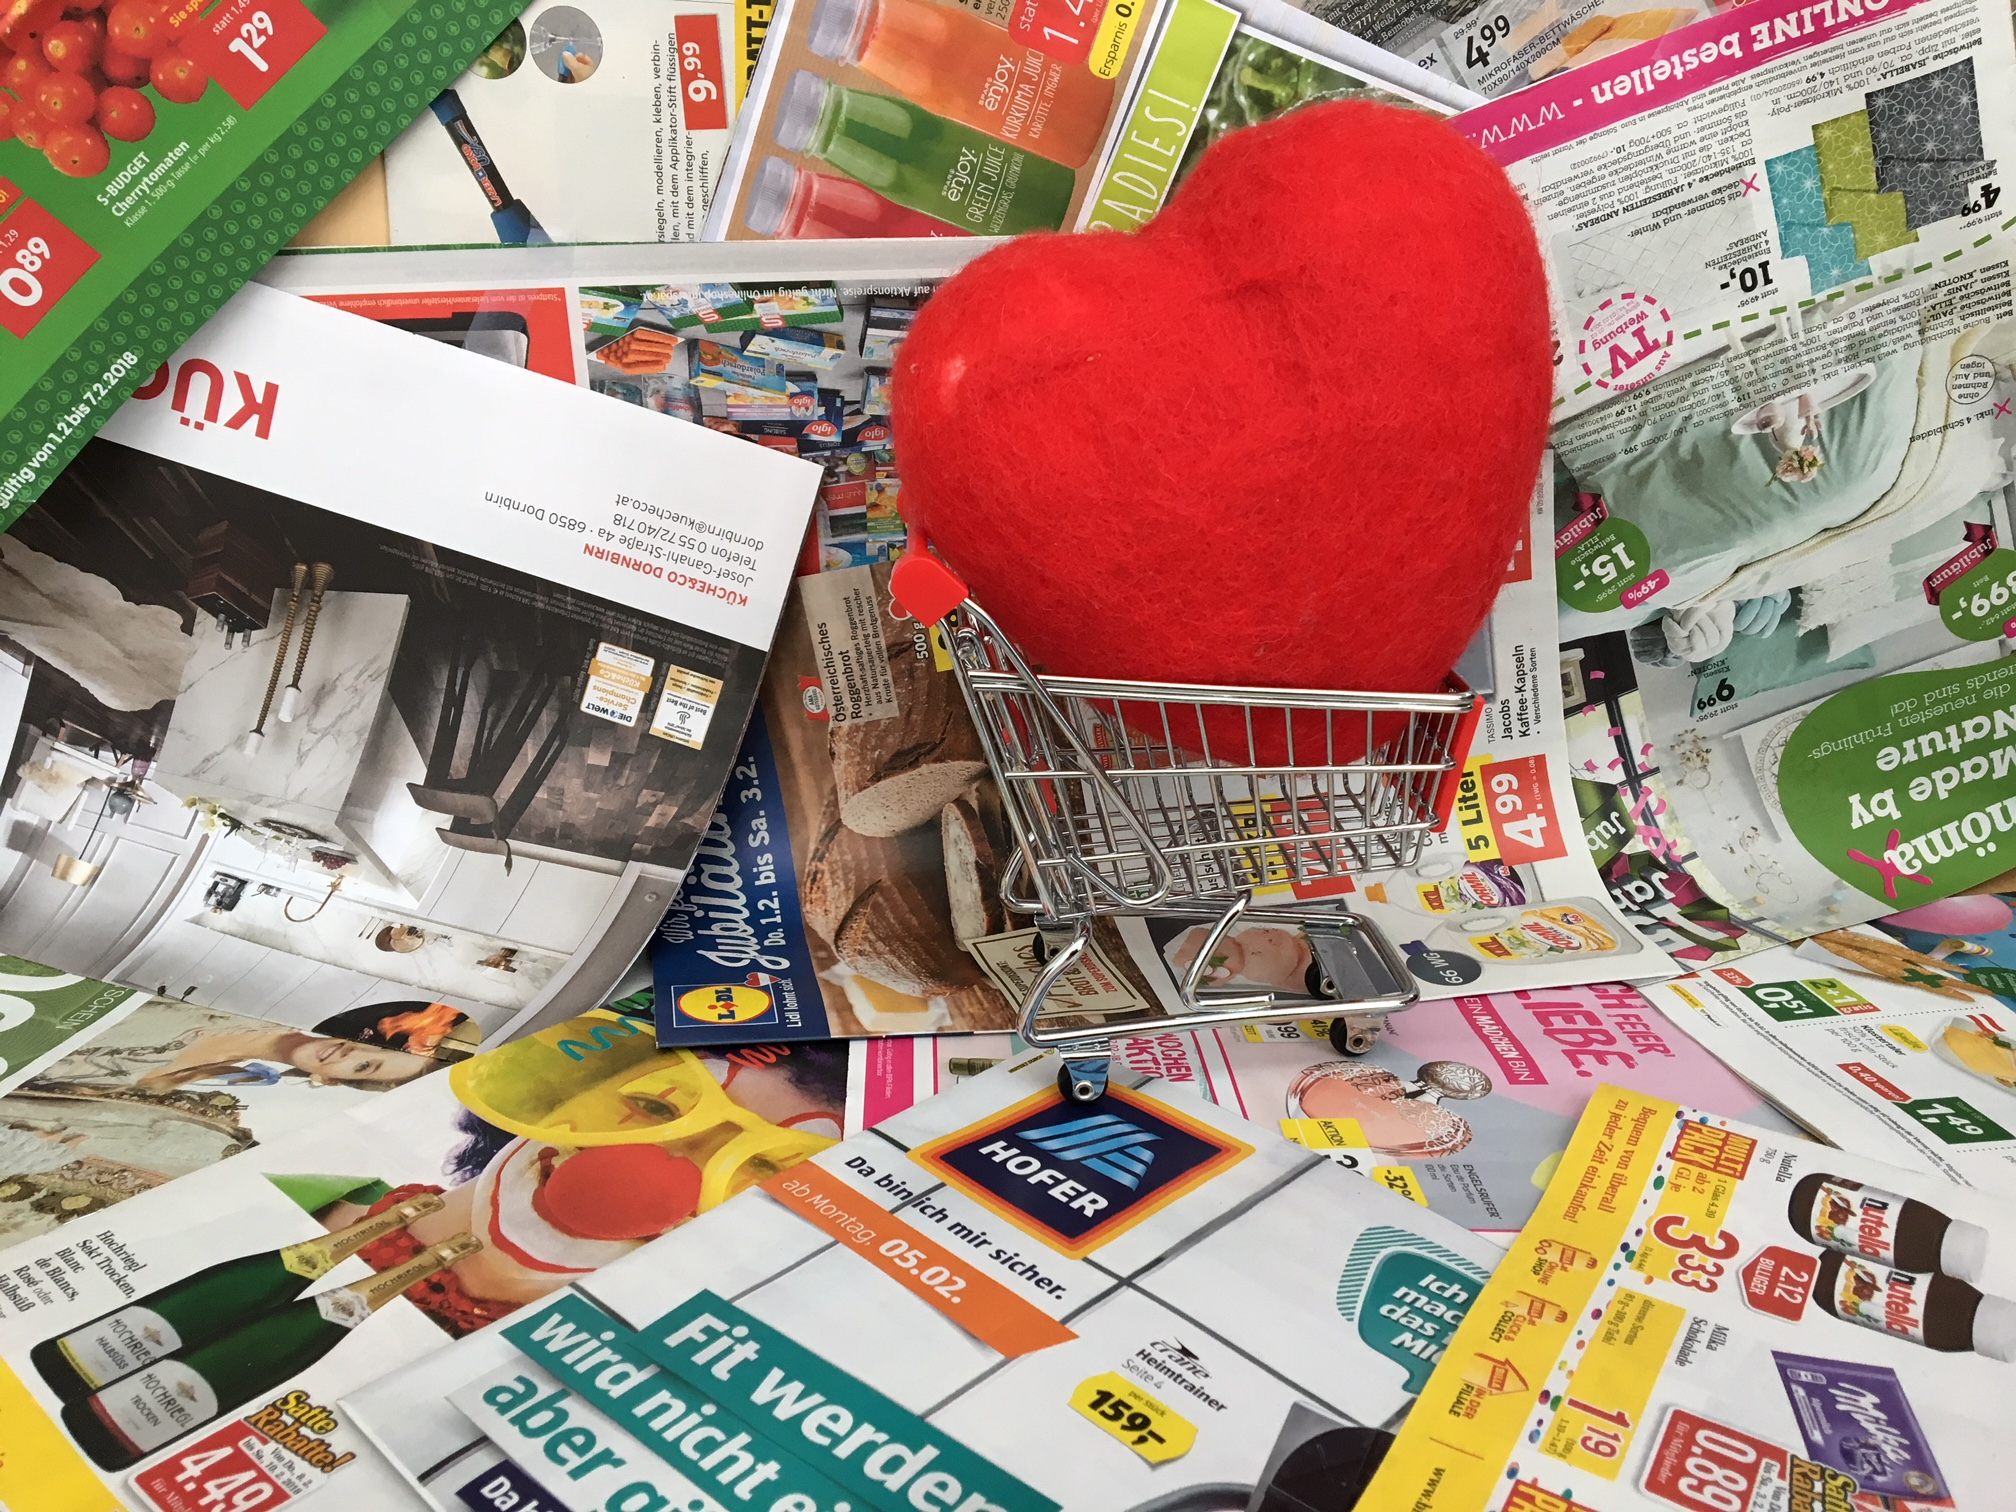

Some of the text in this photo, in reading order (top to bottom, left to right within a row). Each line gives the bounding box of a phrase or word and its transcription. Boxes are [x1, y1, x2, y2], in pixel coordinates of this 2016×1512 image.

[212, 13, 233, 35] statt
[1098, 21, 1128, 78] Ersparnis
[1914, 15, 1981, 47] verschiedenen
[682, 42, 717, 103] 9,99
[1481, 37, 1562, 95] 70X90/140X200CM
[1590, 0, 1887, 109] ONLINE bestellen
[1767, 37, 1983, 117] Bettwäsche Mikrofaser-Poly-
[985, 54, 1015, 112] enjoy.
[1028, 62, 1064, 139] KAROTTE, INGWER
[650, 39, 666, 196] modellieren, kleben, verbin-
[667, 31, 680, 196] dem Applikator-Stift flüssigen
[1001, 84, 1033, 141] KURKUMA
[97, 151, 151, 206] S-BUDGET
[111, 141, 190, 217] Cherrytomaten
[684, 131, 696, 184] integrier-
[699, 149, 710, 212] geschliffen,
[947, 145, 976, 202] enjoy.
[966, 143, 1006, 224] GREEN JUICE
[124, 162, 192, 228] Klasse 500-g-Tasse
[1622, 157, 1757, 216] Einziehdecke JAHRESZEITEN
[1651, 180, 1741, 219] decke verwendbar
[1627, 195, 1727, 239] Sommer- Winter-
[1704, 240, 1764, 269] JAHRESZEITEN
[1719, 260, 1774, 293] 10,-
[1591, 308, 1650, 353] Werbung
[1607, 325, 1663, 380] TV
[28, 439, 56, 469] von
[64, 403, 91, 431] bis
[83, 351, 138, 406] 7.2.2018
[1909, 416, 1965, 444] Schubladen
[484, 491, 754, 588] Josef-Ganahl-Straße 4a 6850 Dornbirn
[614, 493, 765, 552] dornbirn@kuecheco.at
[1570, 534, 1617, 566] Bettwäsche
[583, 543, 750, 607] KÜCHE&CO DORNBIRN
[707, 544, 758, 571] Telefon
[1573, 542, 1638, 592] 15,-
[1928, 538, 1994, 588] Jubiläum
[1627, 577, 1661, 601] -49%
[817, 621, 847, 723] Österreichisches
[843, 596, 873, 707] Herzhaft-saftiges Roggenbrot
[863, 630, 880, 693] Natursauerteig
[865, 595, 894, 703] Kruste Brotgenuss
[912, 633, 929, 662] 500
[592, 683, 638, 706] Champions
[595, 694, 629, 711] Service-
[837, 649, 863, 720] Roggenbrot
[1513, 644, 1531, 738] Kaffee-Kapseln
[1529, 647, 1543, 725] Verschiedene Sorten
[1890, 681, 1961, 719] sind da!
[1486, 708, 1496, 743] TASSIMO
[1500, 698, 1514, 741] Jacobs
[1807, 680, 2012, 764] die neuesten Frühlings-
[1876, 706, 2016, 771] Nature
[1490, 772, 1549, 849] 4.99
[1849, 748, 2016, 831] Made by
[735, 755, 787, 946] Do. 1.2. bis Sa. 3.2.
[1466, 832, 1490, 851] 5
[1754, 986, 1815, 1017] 0,51
[1809, 978, 1860, 1005] 2+1
[1472, 1013, 1536, 1083] MÄDCHEN BIN
[1859, 1024, 1907, 1058] Klostertaler
[1846, 1063, 1878, 1083] 0,40
[1320, 1118, 1347, 1148] AKTION
[1674, 1121, 1727, 1172] PACK
[1914, 1102, 1984, 1138] 1,49
[978, 1140, 1109, 1219] HOFER
[1562, 1111, 1622, 1224] jeder Zeit einkaufen!
[1597, 1105, 1657, 1215] Bequem von überall
[1775, 1150, 1798, 1184] Nutella
[96, 1229, 148, 1273] Hochriegl
[332, 1218, 391, 1251] HOCHRIEGL
[782, 1178, 968, 1305] ab Montag, 05.02.
[843, 1154, 1073, 1301] Da bin ich mir sicher.
[1857, 1196, 1891, 1262] nutella
[13, 1264, 40, 1289] Rosé
[45, 1265, 81, 1302] Blancs,
[55, 1246, 86, 1275] Blanc
[75, 1238, 137, 1299] Sekt Trocken,
[367, 1262, 429, 1295] HOCHRIEGL
[1416, 1272, 1470, 1304] Ich
[1749, 1256, 1776, 1297] BILLIGER
[1773, 1265, 1810, 1305] 2.12
[0, 1273, 37, 1313] Halbsüß
[1379, 1302, 1441, 1338] das
[1884, 1270, 1920, 1336] nutella
[95, 1335, 131, 1371] HALBSÜSS
[662, 1310, 761, 1382] Fit
[1488, 1310, 1515, 1344] COLLECT
[1674, 1316, 1709, 1368] Schokolade
[1705, 1323, 1731, 1352] Milka
[1121, 1358, 1154, 1386] Seite
[1134, 1348, 1229, 1413] Heimtrainer
[129, 1394, 163, 1428] TROCKEN
[139, 1372, 194, 1429] HOCHRIEGL
[275, 1389, 338, 1435] Satte
[527, 1312, 783, 1502] wird nicht
[1086, 1388, 1167, 1448] 159,-
[1448, 1384, 1475, 1418] FILIALE
[1827, 1381, 1911, 1466] Milka
[245, 1406, 357, 1474] Rabatte!
[481, 1374, 629, 1483] aber
[1657, 1434, 1684, 1485] Mitglieder
